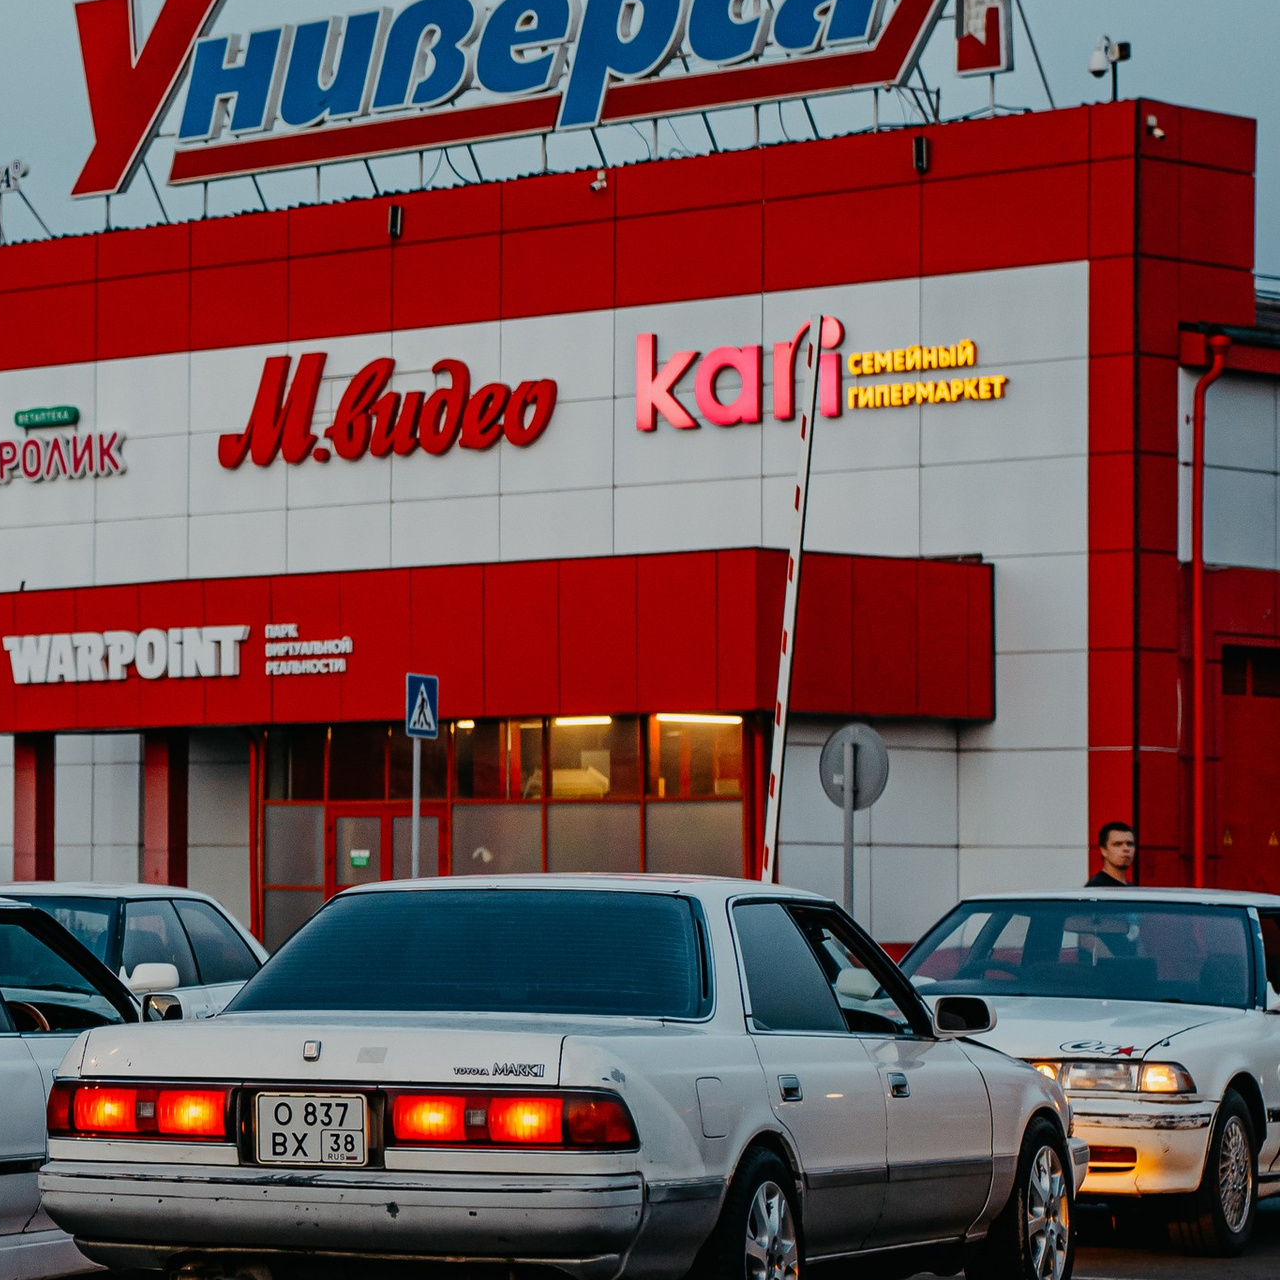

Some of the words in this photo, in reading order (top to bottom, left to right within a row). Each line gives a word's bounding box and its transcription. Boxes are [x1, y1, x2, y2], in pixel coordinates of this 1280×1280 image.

[847, 339, 977, 375] СЕМЕЙНЫЙ
[636, 315, 845, 431] kari
[847, 374, 1008, 409] ГИПЕРМАРКЕТ
[265, 623, 299, 639] ПАРК
[265, 635, 354, 657] ВИРТУАЛЬНОЙ
[265, 658, 347, 676] РЕАЛЬНОСТИ
[453, 1067, 490, 1076] TOYOTA
[304, 1102, 349, 1127] 837
[330, 1133, 355, 1152] 38
